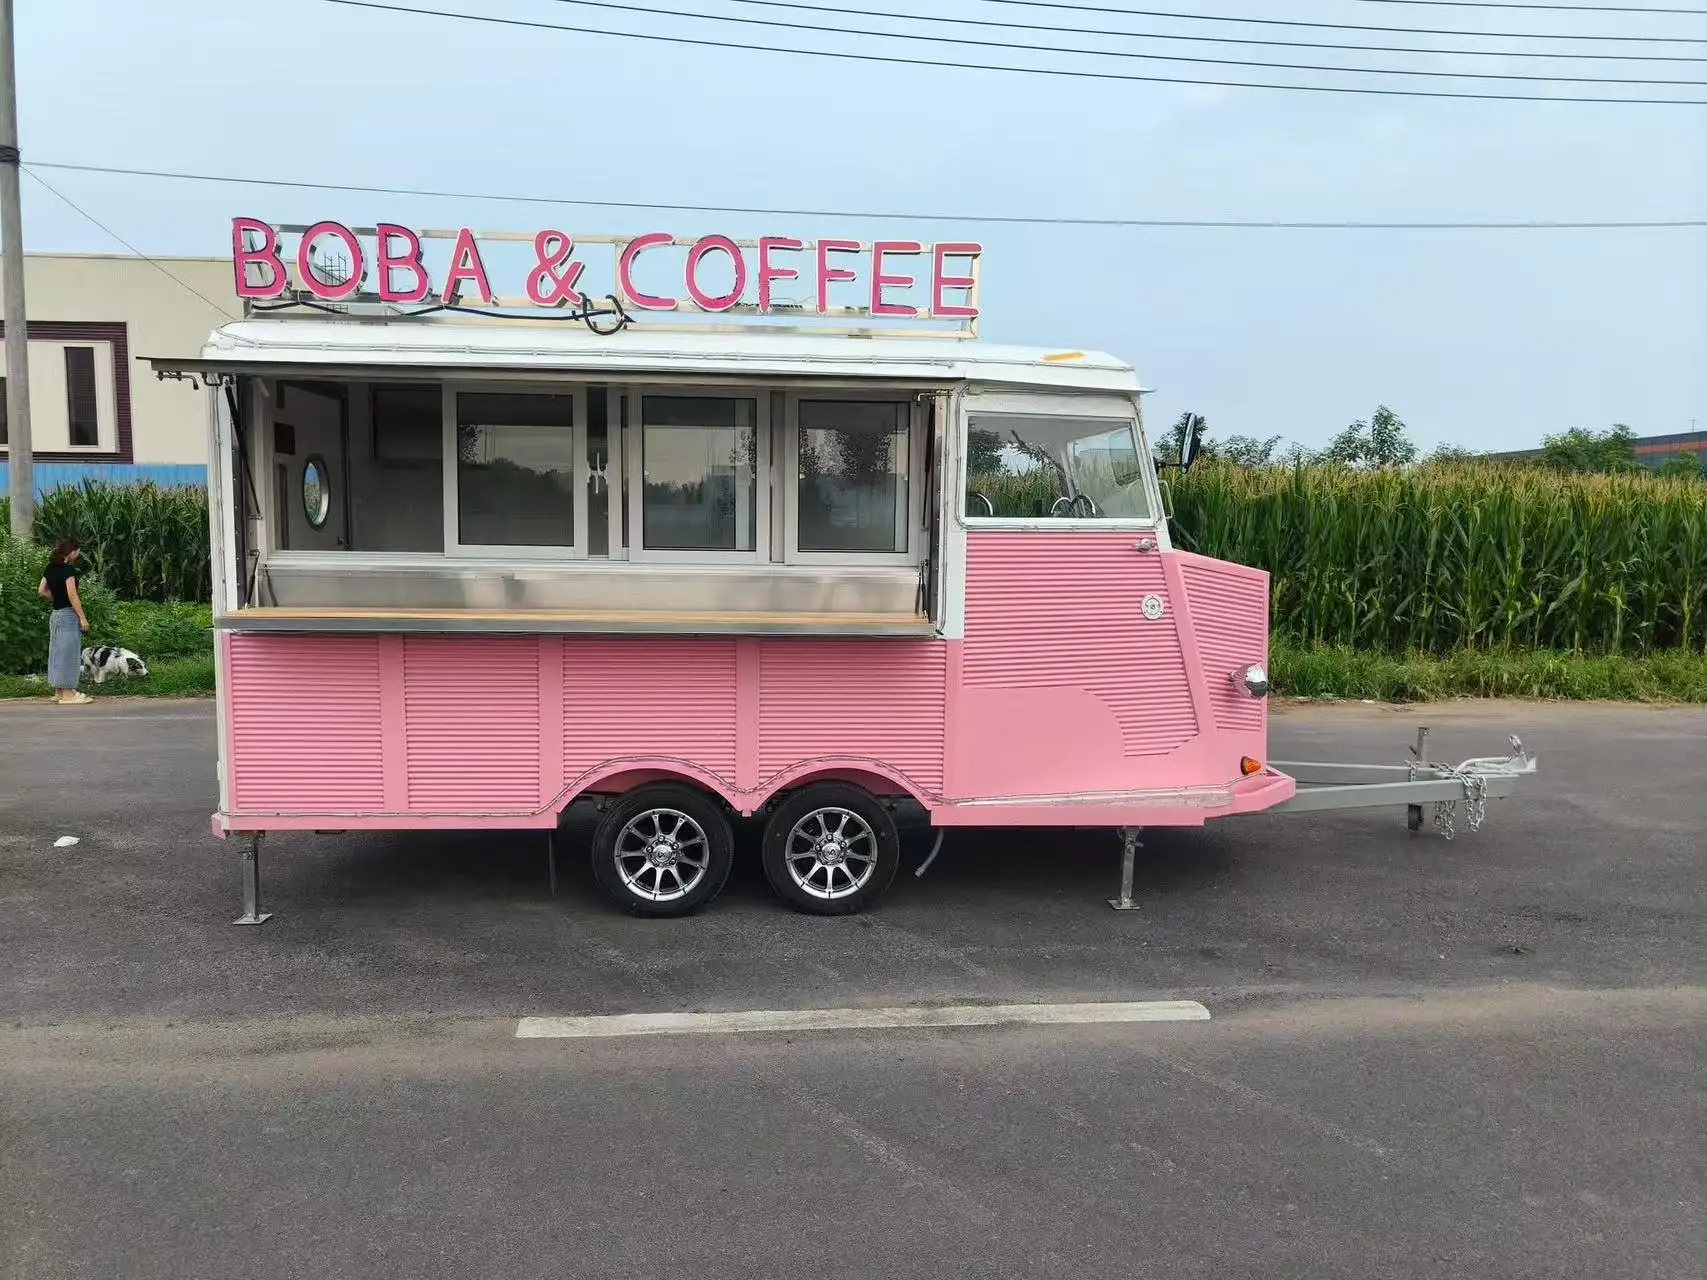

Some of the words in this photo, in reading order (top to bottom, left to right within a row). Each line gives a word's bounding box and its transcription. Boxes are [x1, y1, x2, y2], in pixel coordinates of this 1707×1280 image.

[232, 217, 498, 306] BOBA
[525, 229, 586, 307] &
[620, 233, 983, 318] COFFEE
